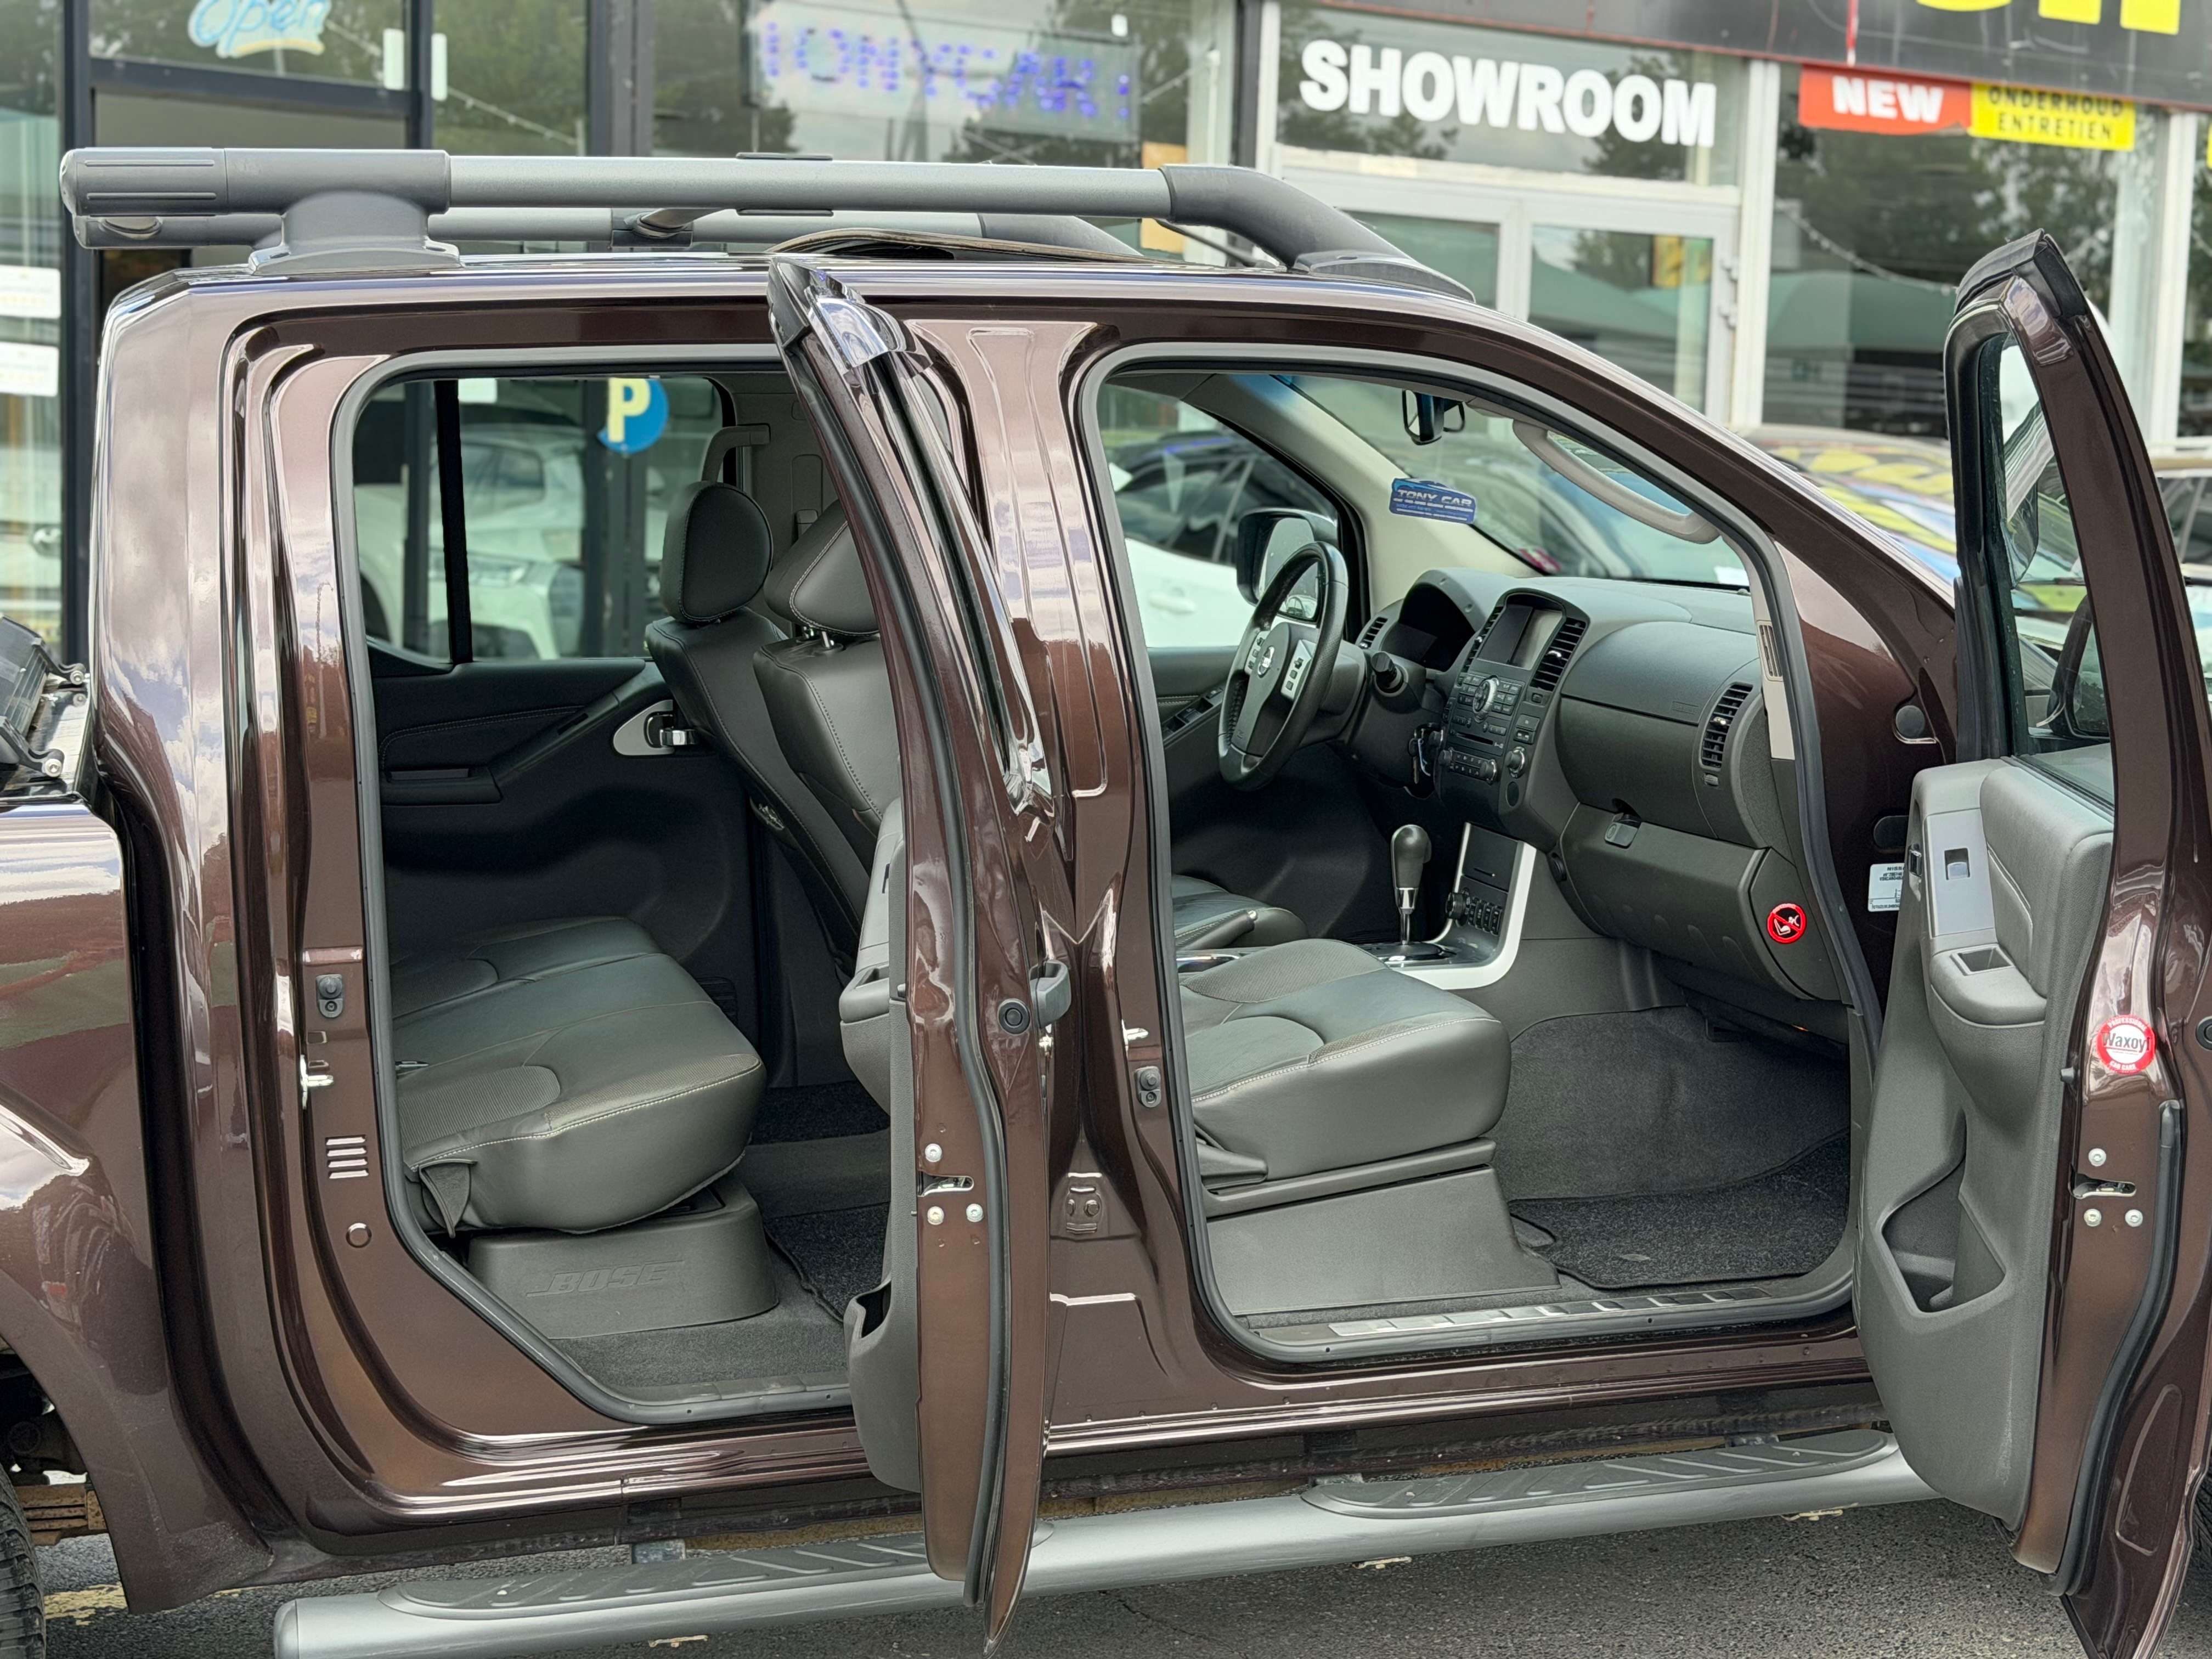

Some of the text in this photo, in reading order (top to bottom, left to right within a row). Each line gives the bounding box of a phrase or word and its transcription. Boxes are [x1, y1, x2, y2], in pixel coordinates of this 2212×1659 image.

[1300, 39, 1717, 148] SHOWROOM
[1832, 76, 1944, 124] NEW
[1988, 86, 2123, 117] ONDERHOUD
[1998, 112, 2112, 140] ENTRETIEN
[608, 378, 651, 443] P
[1397, 489, 1472, 507] TONY CAR
[528, 1260, 684, 1297] BOSE
